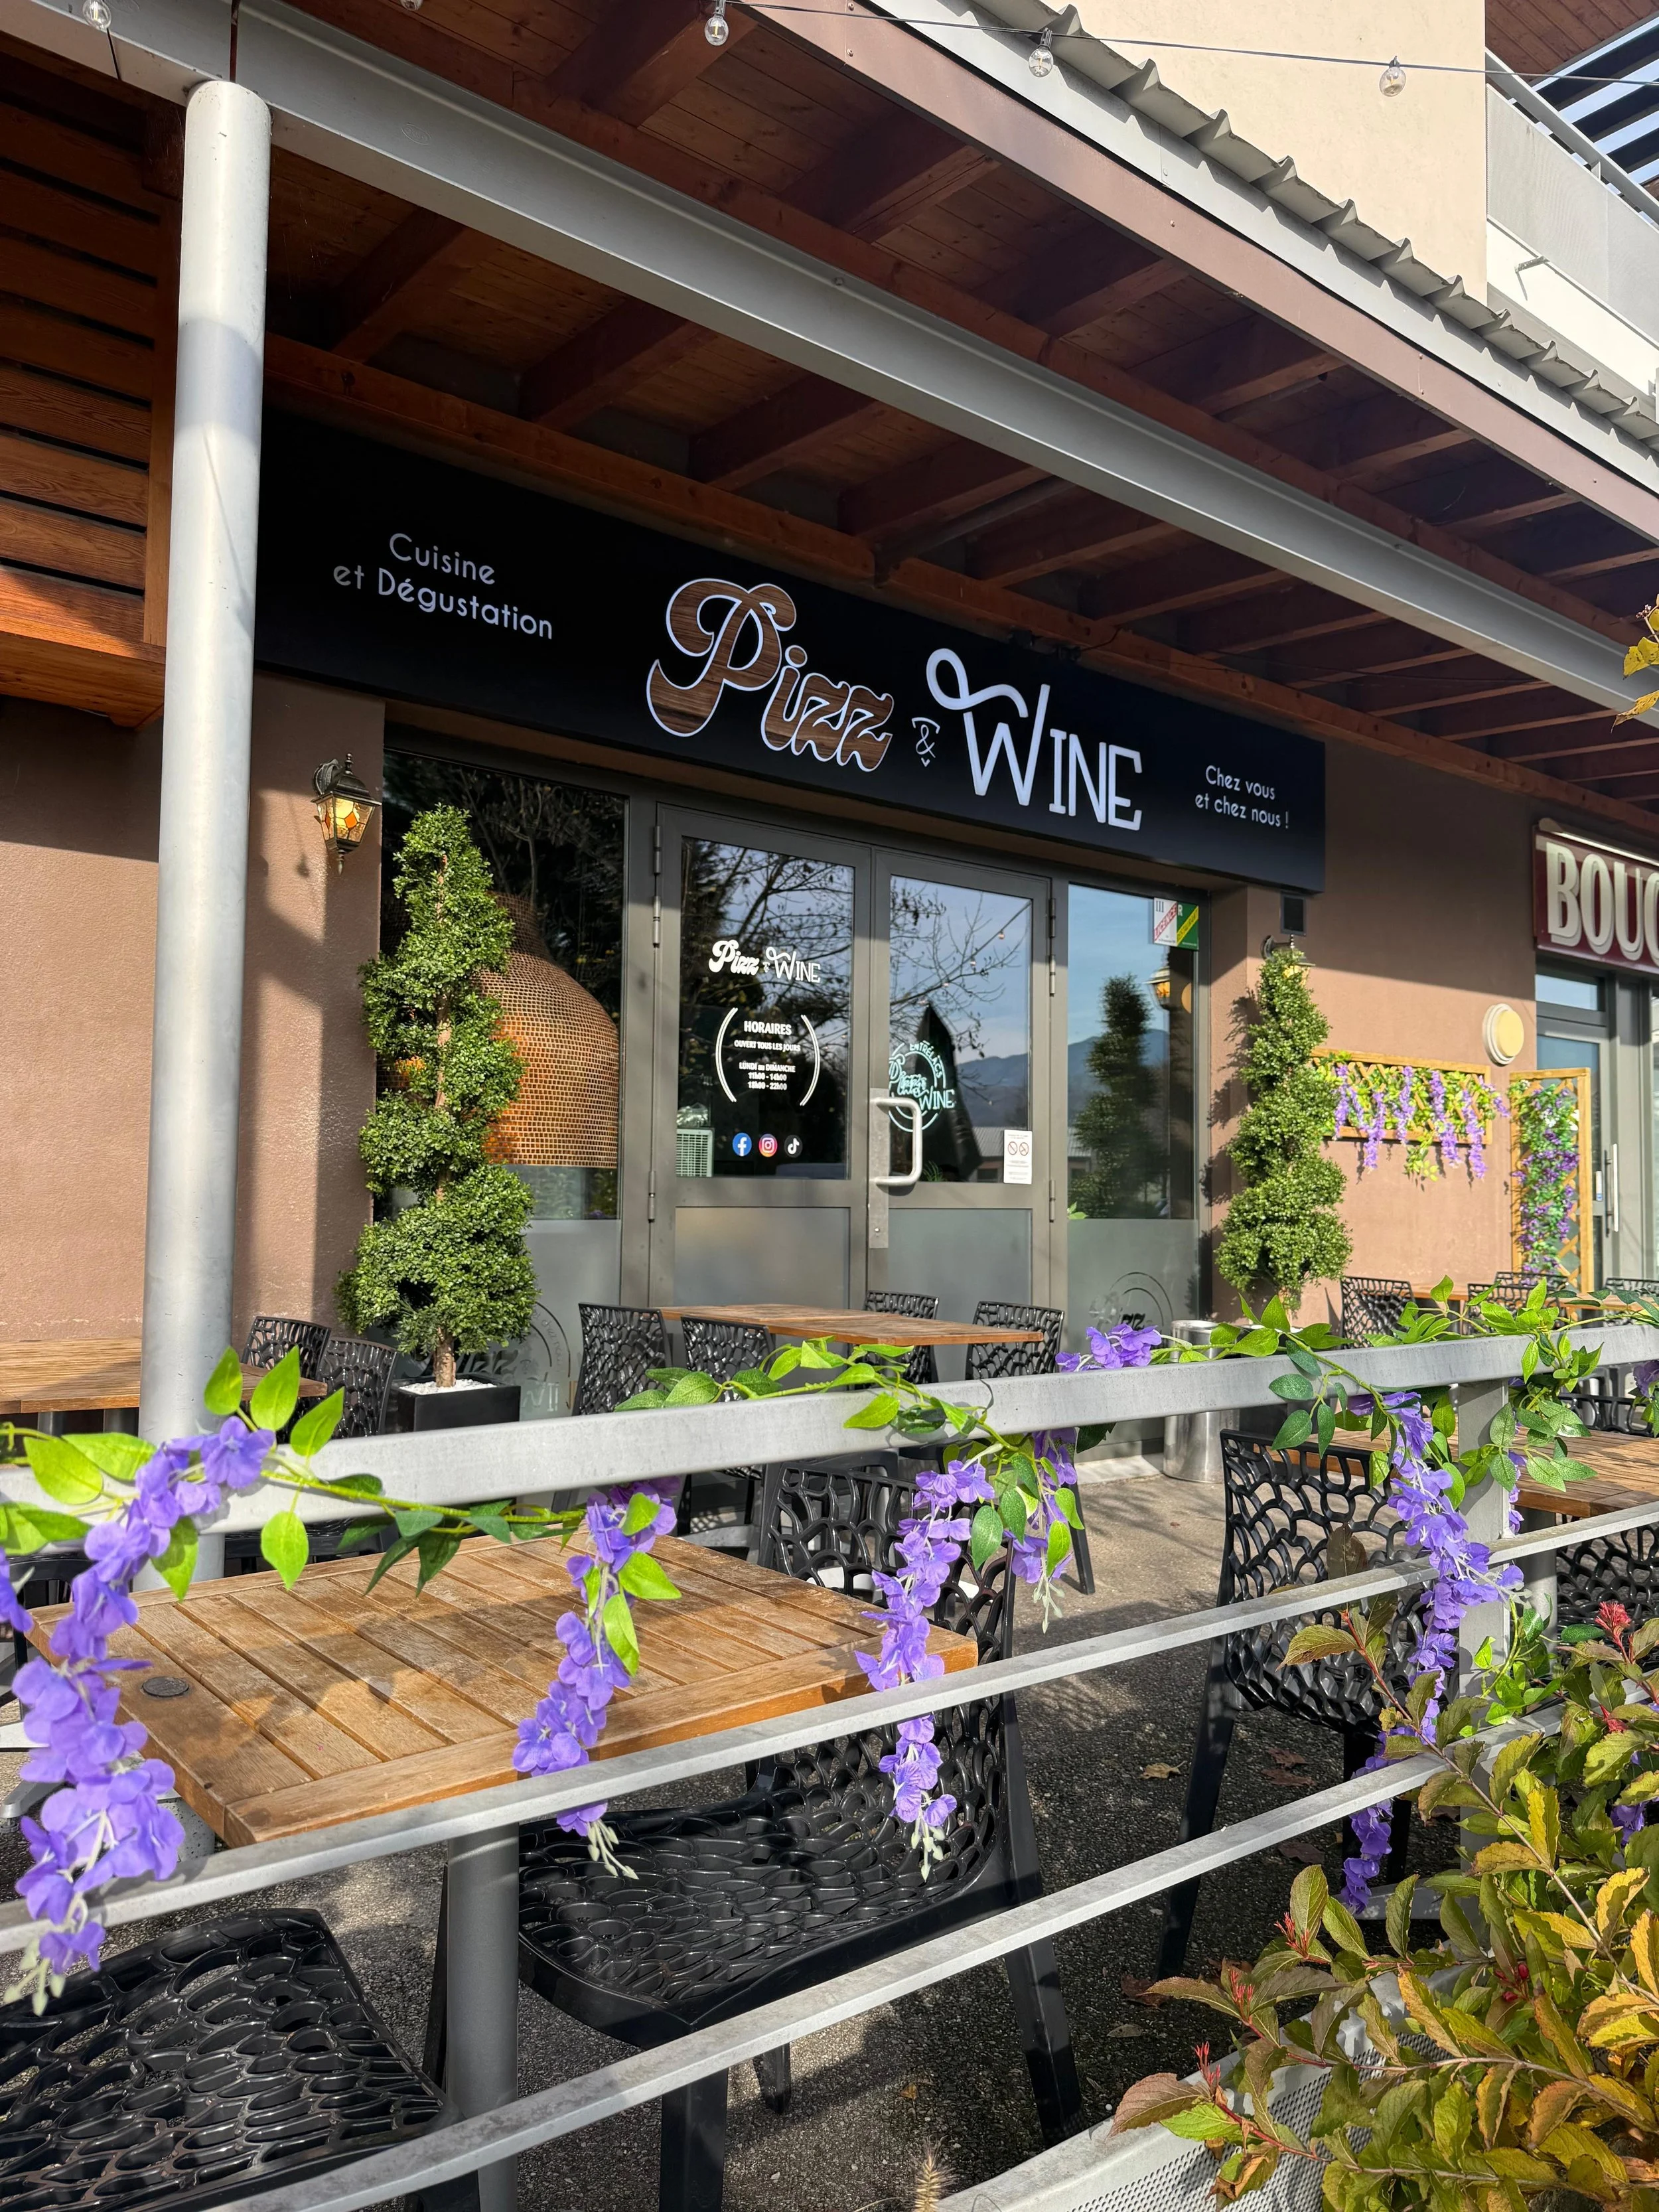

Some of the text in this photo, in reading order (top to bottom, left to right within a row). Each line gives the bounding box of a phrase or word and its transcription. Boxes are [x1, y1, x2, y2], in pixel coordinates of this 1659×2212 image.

[390, 533, 495, 585] Cuisine
[333, 565, 553, 640] et Dégustation
[646, 577, 895, 773] Pizz
[1206, 765, 1275, 800] Chez vous
[1194, 792, 1210, 810] et
[1214, 795, 1246, 819] chez
[1252, 808, 1281, 828] nous
[708, 939, 760, 976] Pizz
[734, 1040, 757, 1049] OUVERT
[744, 1021, 792, 1035] HORAIRES
[766, 1064, 796, 1072] DIMANCHE
